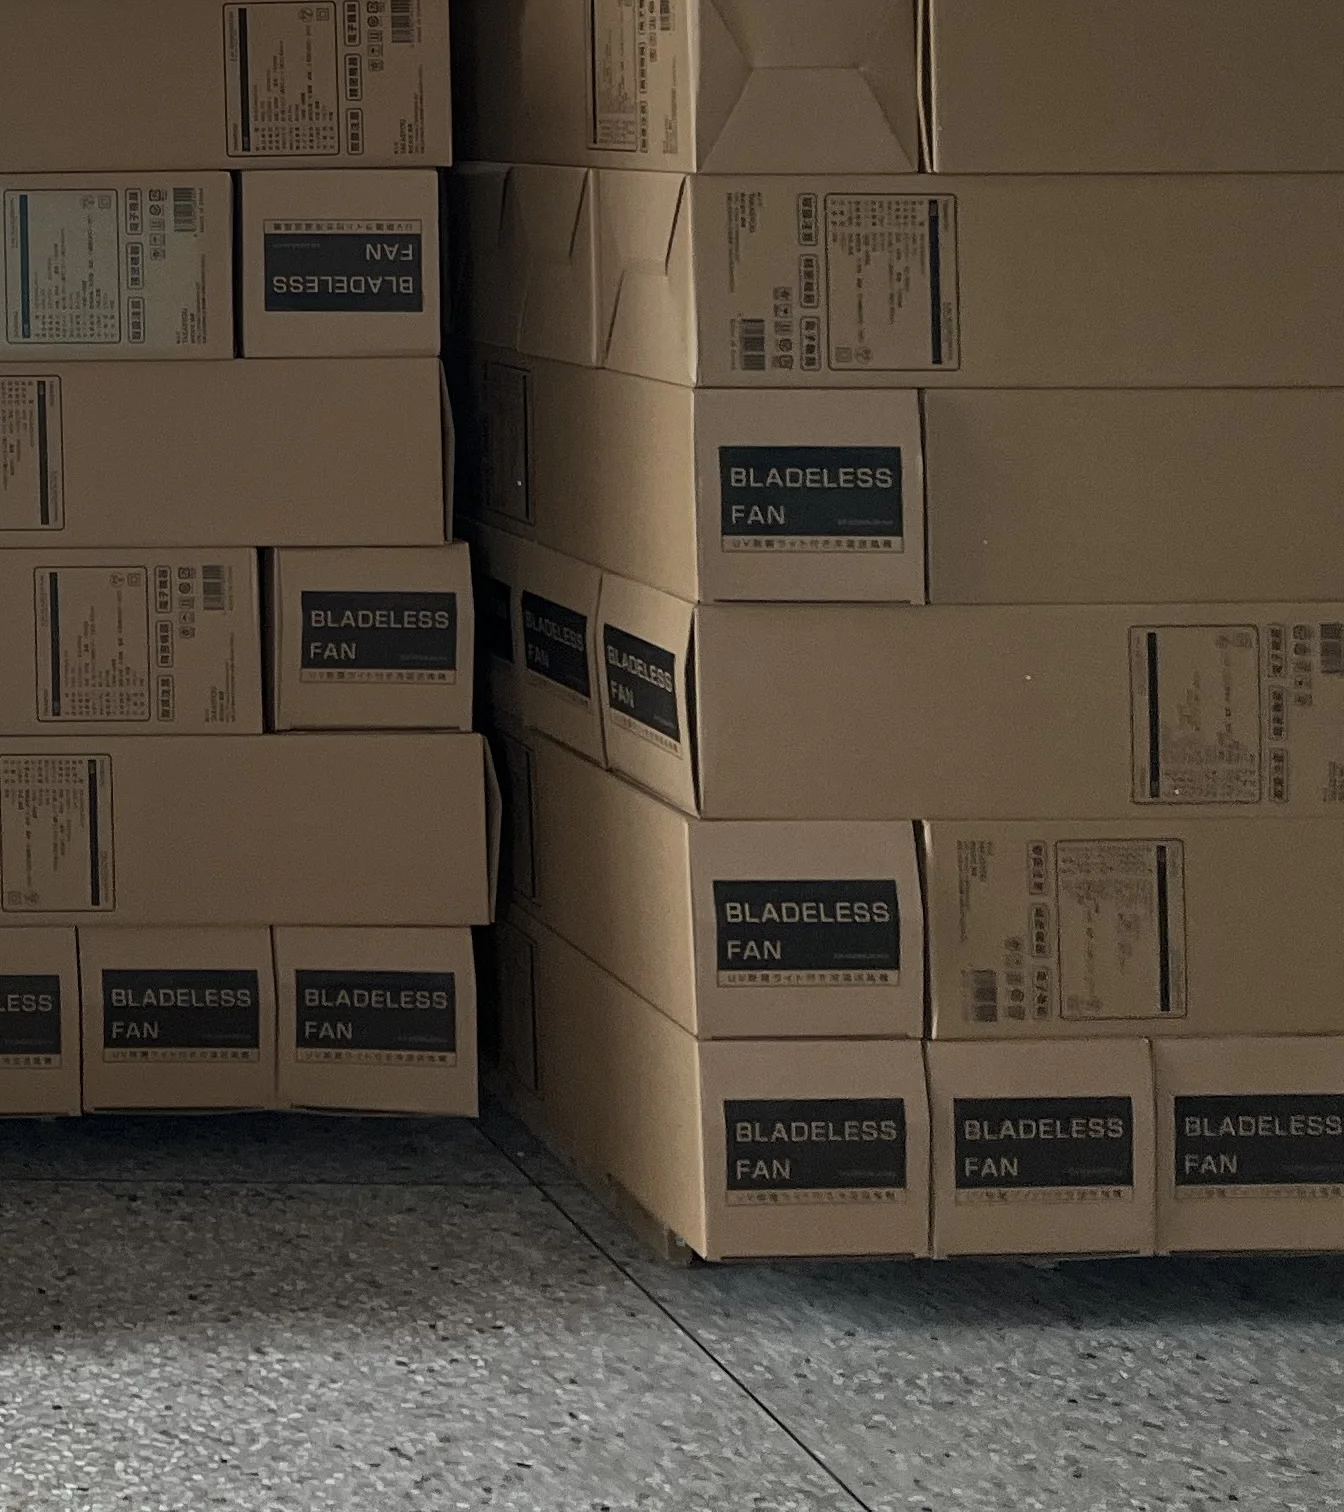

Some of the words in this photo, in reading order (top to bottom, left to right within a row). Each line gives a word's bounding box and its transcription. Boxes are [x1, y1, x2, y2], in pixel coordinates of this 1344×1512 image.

[366, 244, 412, 260] FAN
[273, 276, 413, 293] BLADELESS
[731, 468, 892, 487] BLADELESS
[732, 506, 784, 524] FAN
[312, 611, 448, 628] BLADELESS
[311, 643, 356, 659] FAN
[606, 645, 673, 693] BLADELESS
[610, 681, 635, 709] FAN
[726, 902, 889, 922] BLADELESS
[728, 941, 780, 959] FAN
[112, 989, 251, 1006] BLADELESS
[305, 989, 447, 1009] BLADELESS
[112, 1022, 158, 1038] FAN
[306, 1022, 352, 1039] FAN
[737, 1121, 896, 1141] BLADELESS
[965, 1119, 1123, 1139] BLADELESS
[1186, 1115, 1340, 1136] BLADELESS
[737, 1160, 789, 1179] FAN
[965, 1158, 1017, 1176] FAN
[1185, 1155, 1237, 1173] FAN
